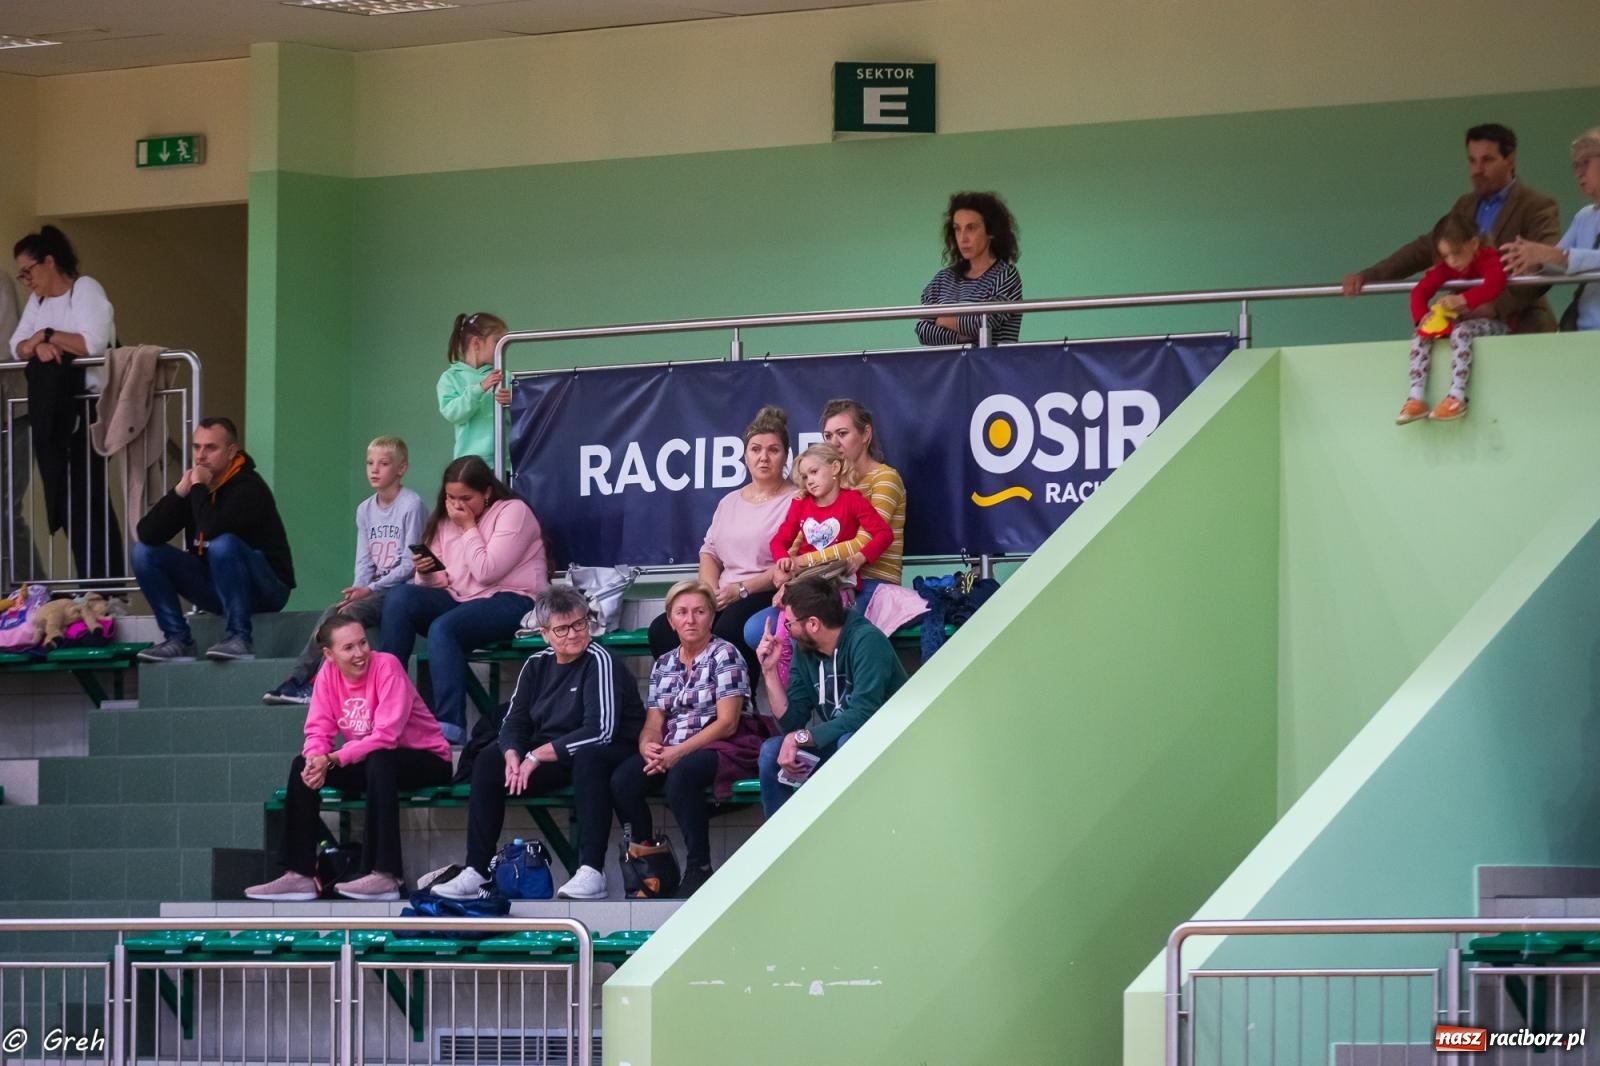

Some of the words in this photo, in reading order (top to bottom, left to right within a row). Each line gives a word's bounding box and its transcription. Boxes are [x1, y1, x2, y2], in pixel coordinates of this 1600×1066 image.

[856, 67, 915, 80] SEKTOR
[863, 87, 909, 125] E
[579, 431, 826, 497] RACIB
